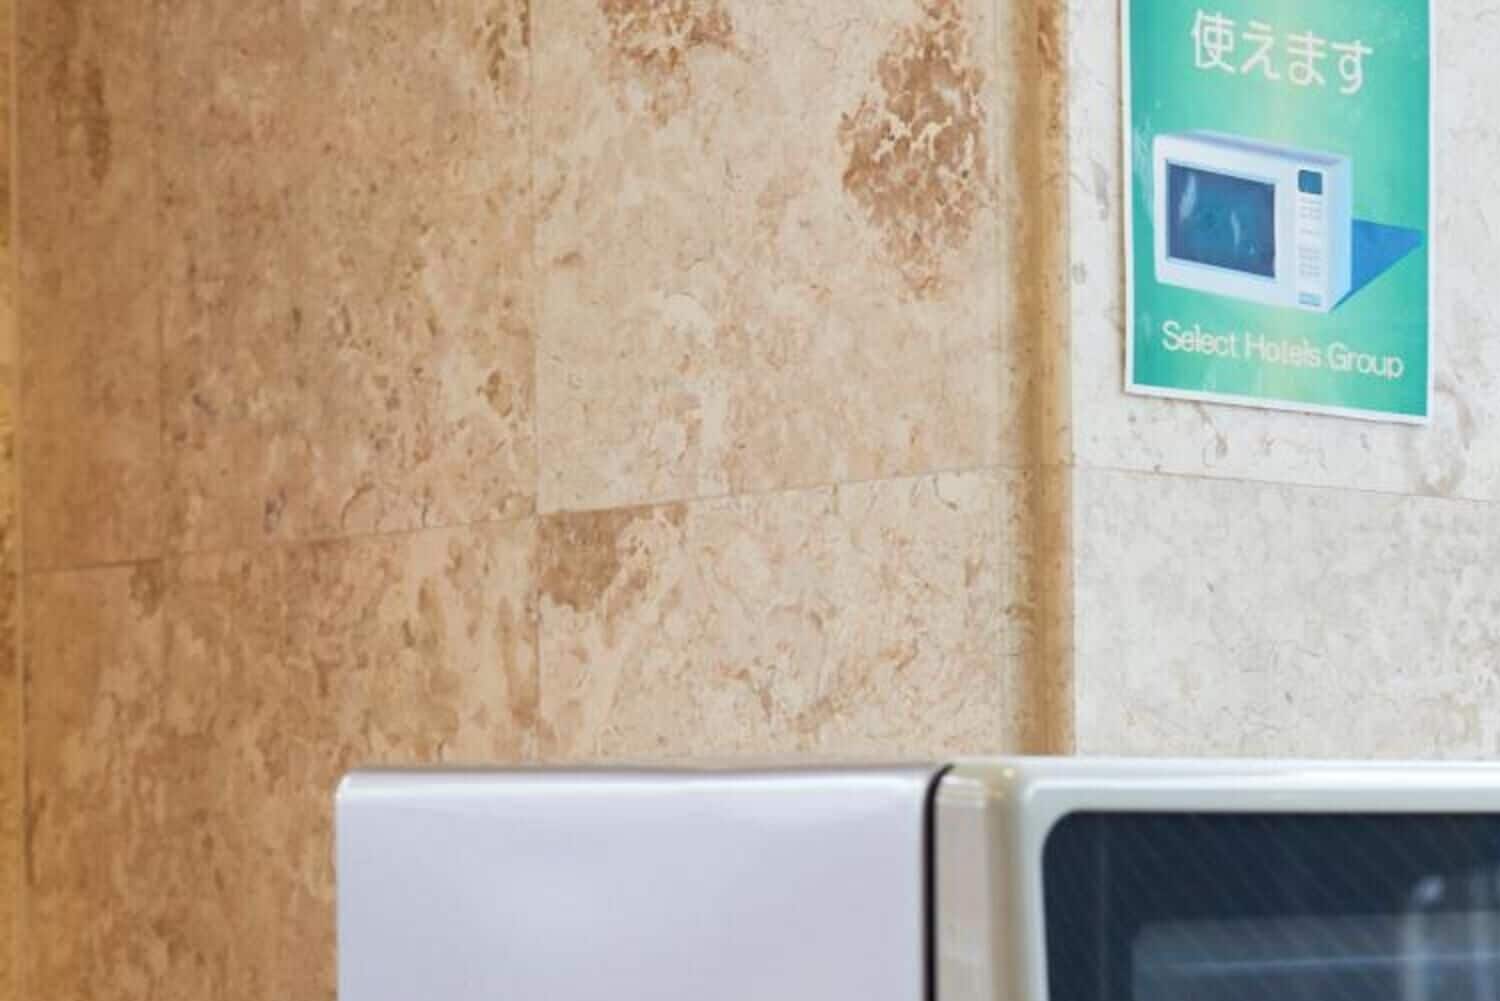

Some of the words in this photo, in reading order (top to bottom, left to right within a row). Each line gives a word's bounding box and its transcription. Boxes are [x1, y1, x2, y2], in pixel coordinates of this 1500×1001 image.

[1189, 9, 1374, 95] 使えます
[1161, 319, 1238, 358] Select
[1245, 330, 1321, 368] Hotels
[1327, 341, 1405, 380] Group
